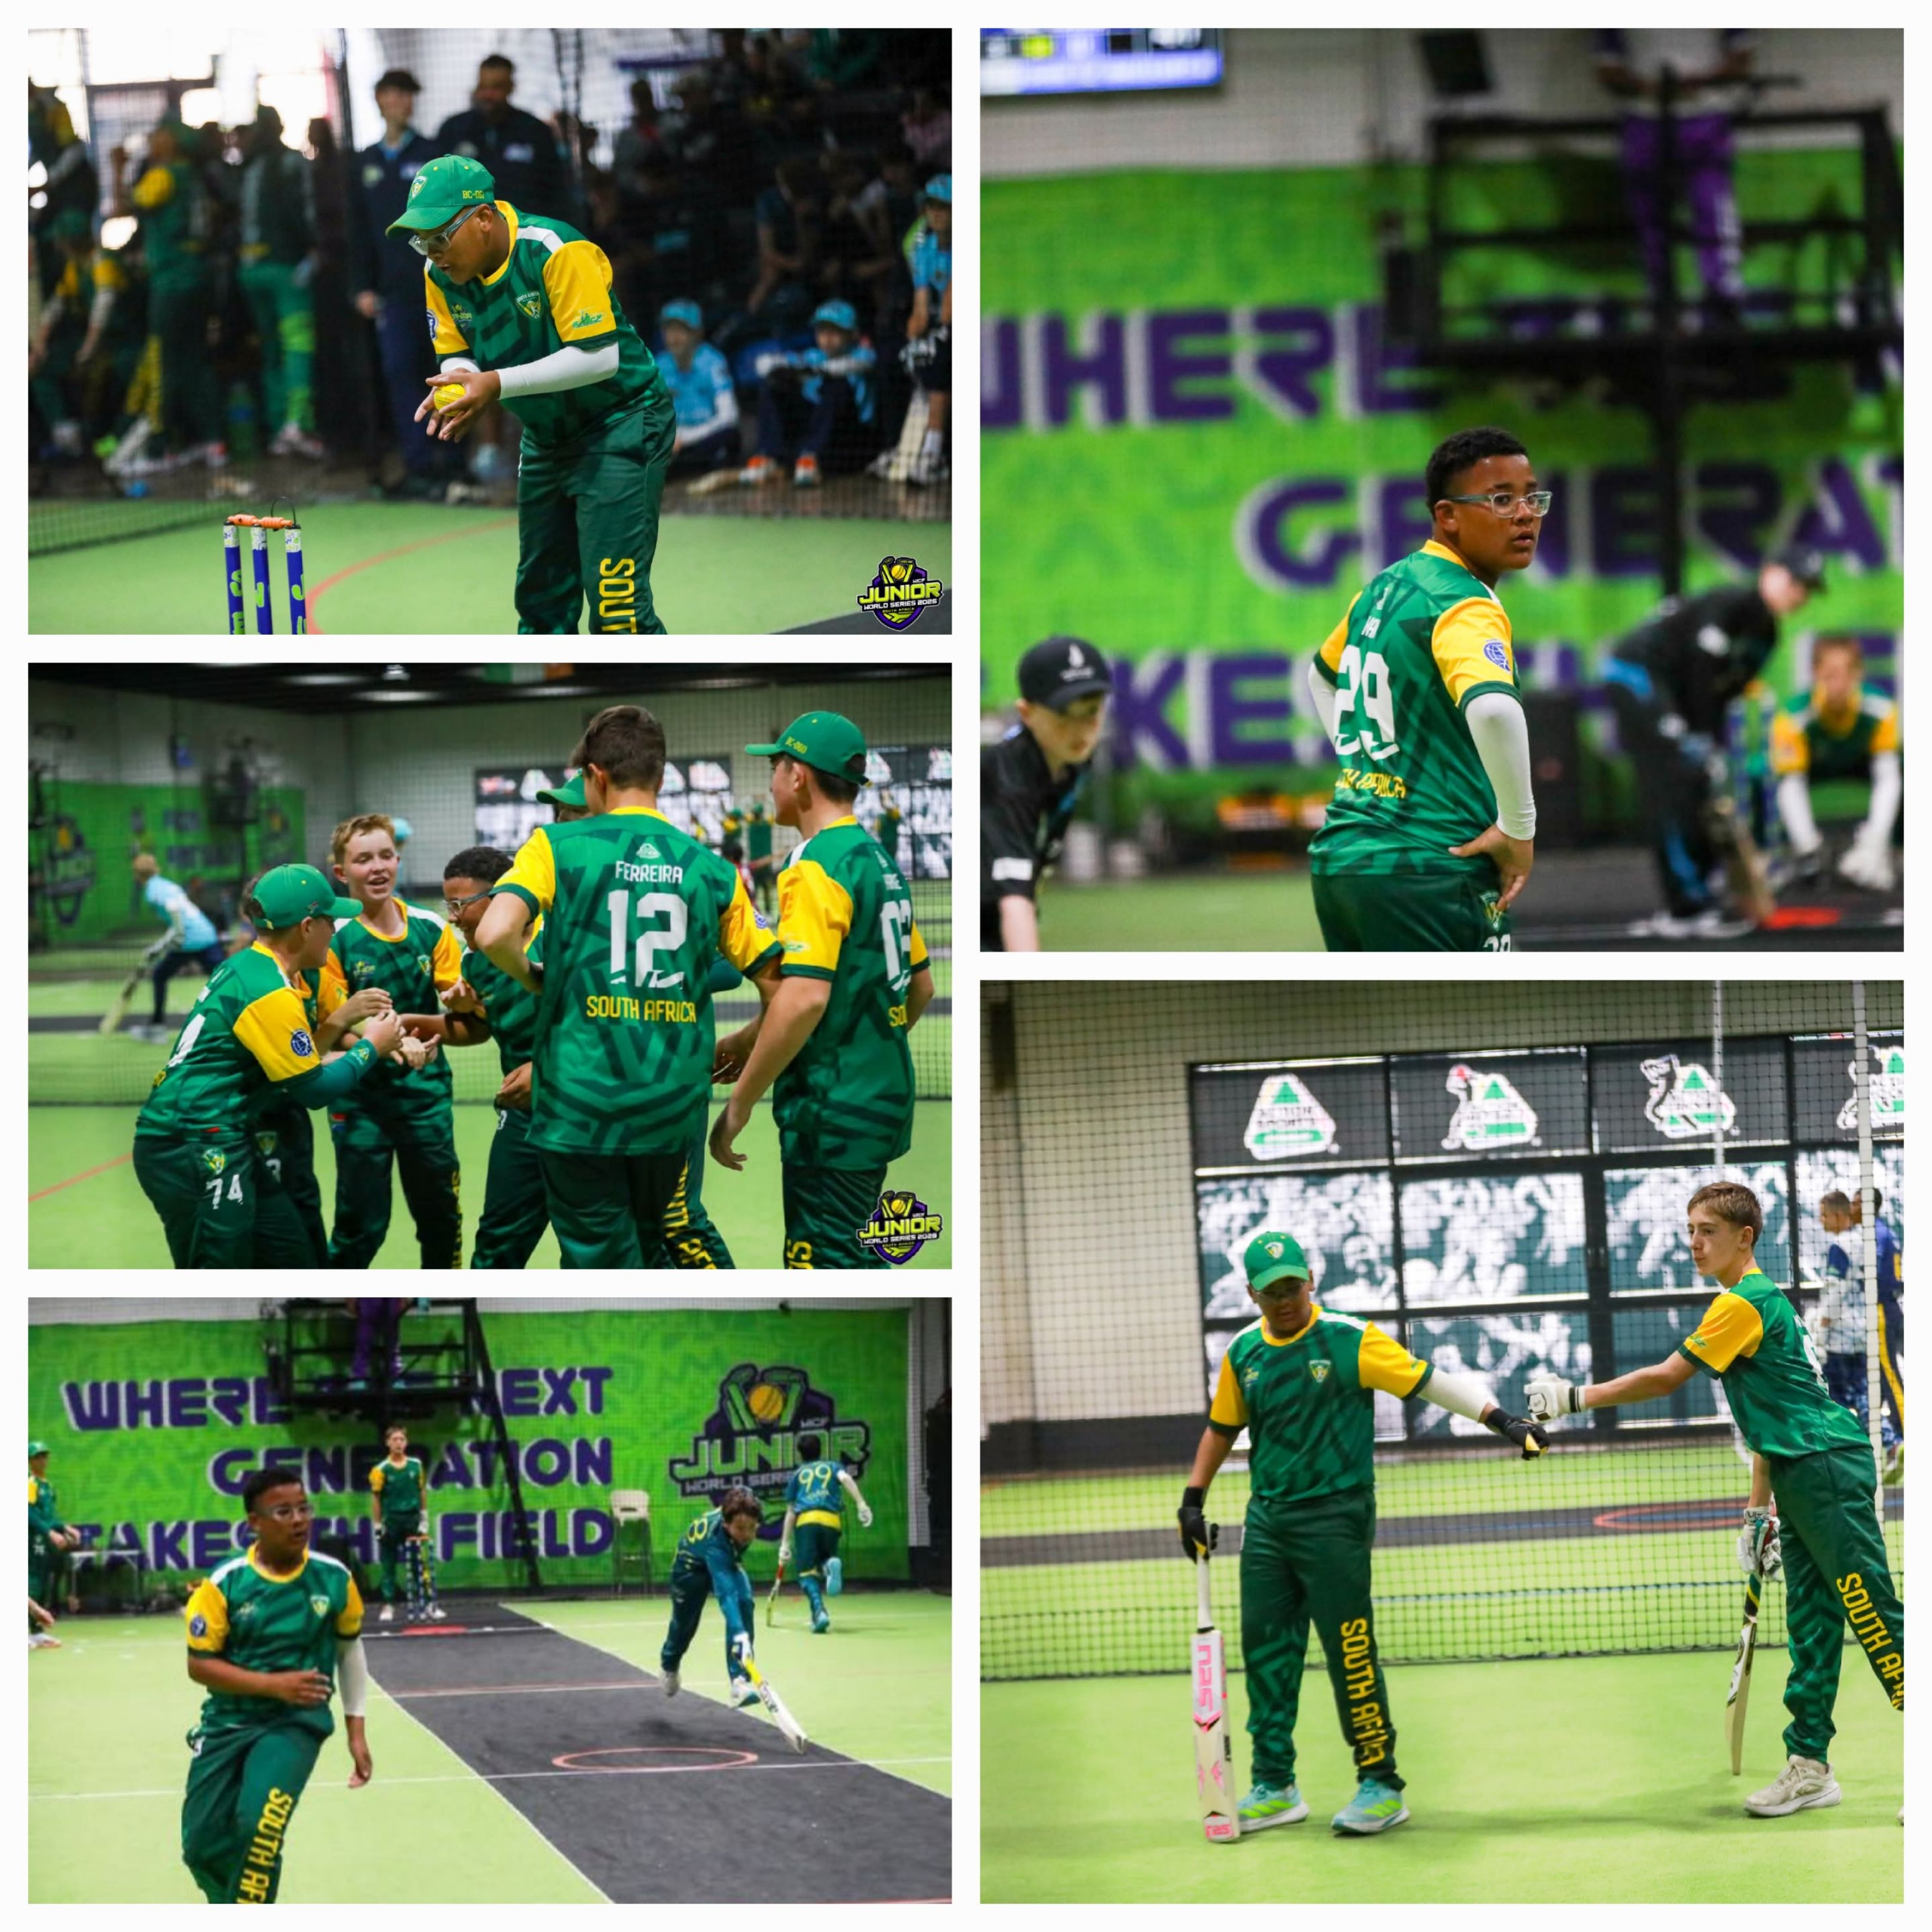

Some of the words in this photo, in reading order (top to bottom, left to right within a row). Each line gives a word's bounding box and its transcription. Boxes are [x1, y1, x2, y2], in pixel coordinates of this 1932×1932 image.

[1334, 645, 1400, 761] 29
[615, 860, 683, 884] FERREIRA
[608, 889, 688, 989] 12
[586, 995, 640, 1020] SOUTH
[644, 1000, 697, 1023] AFRICA
[205, 1174, 244, 1210] 74
[798, 1463, 832, 1494] 99
[1836, 1572, 1893, 1653] SOUTH
[1340, 1617, 1376, 1700] SOUTH
[248, 1786, 293, 1867] SOUTH
